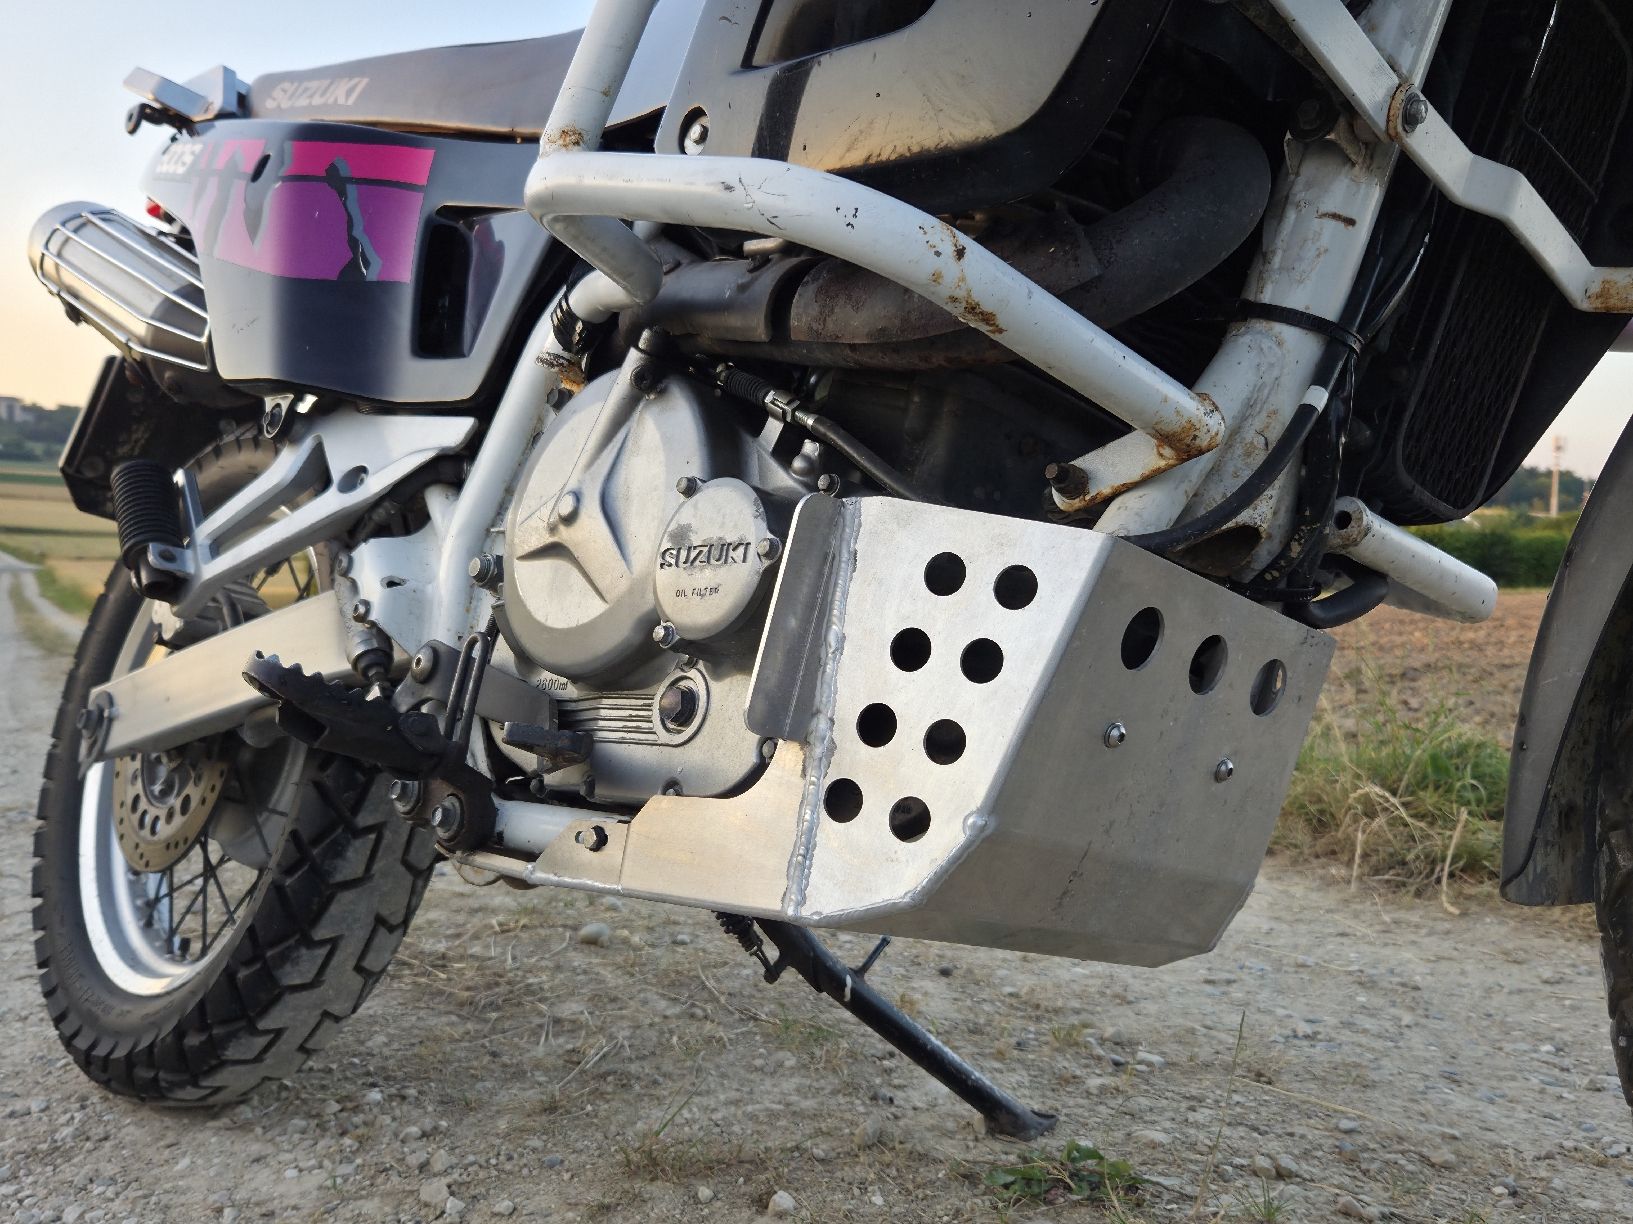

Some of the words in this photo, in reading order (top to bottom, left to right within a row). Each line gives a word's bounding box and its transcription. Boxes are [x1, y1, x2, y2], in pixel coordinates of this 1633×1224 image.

[265, 77, 370, 109] SUZUKI
[660, 542, 751, 569] SUZUKI
[675, 589, 688, 598] OIL
[691, 586, 720, 597] FILTER
